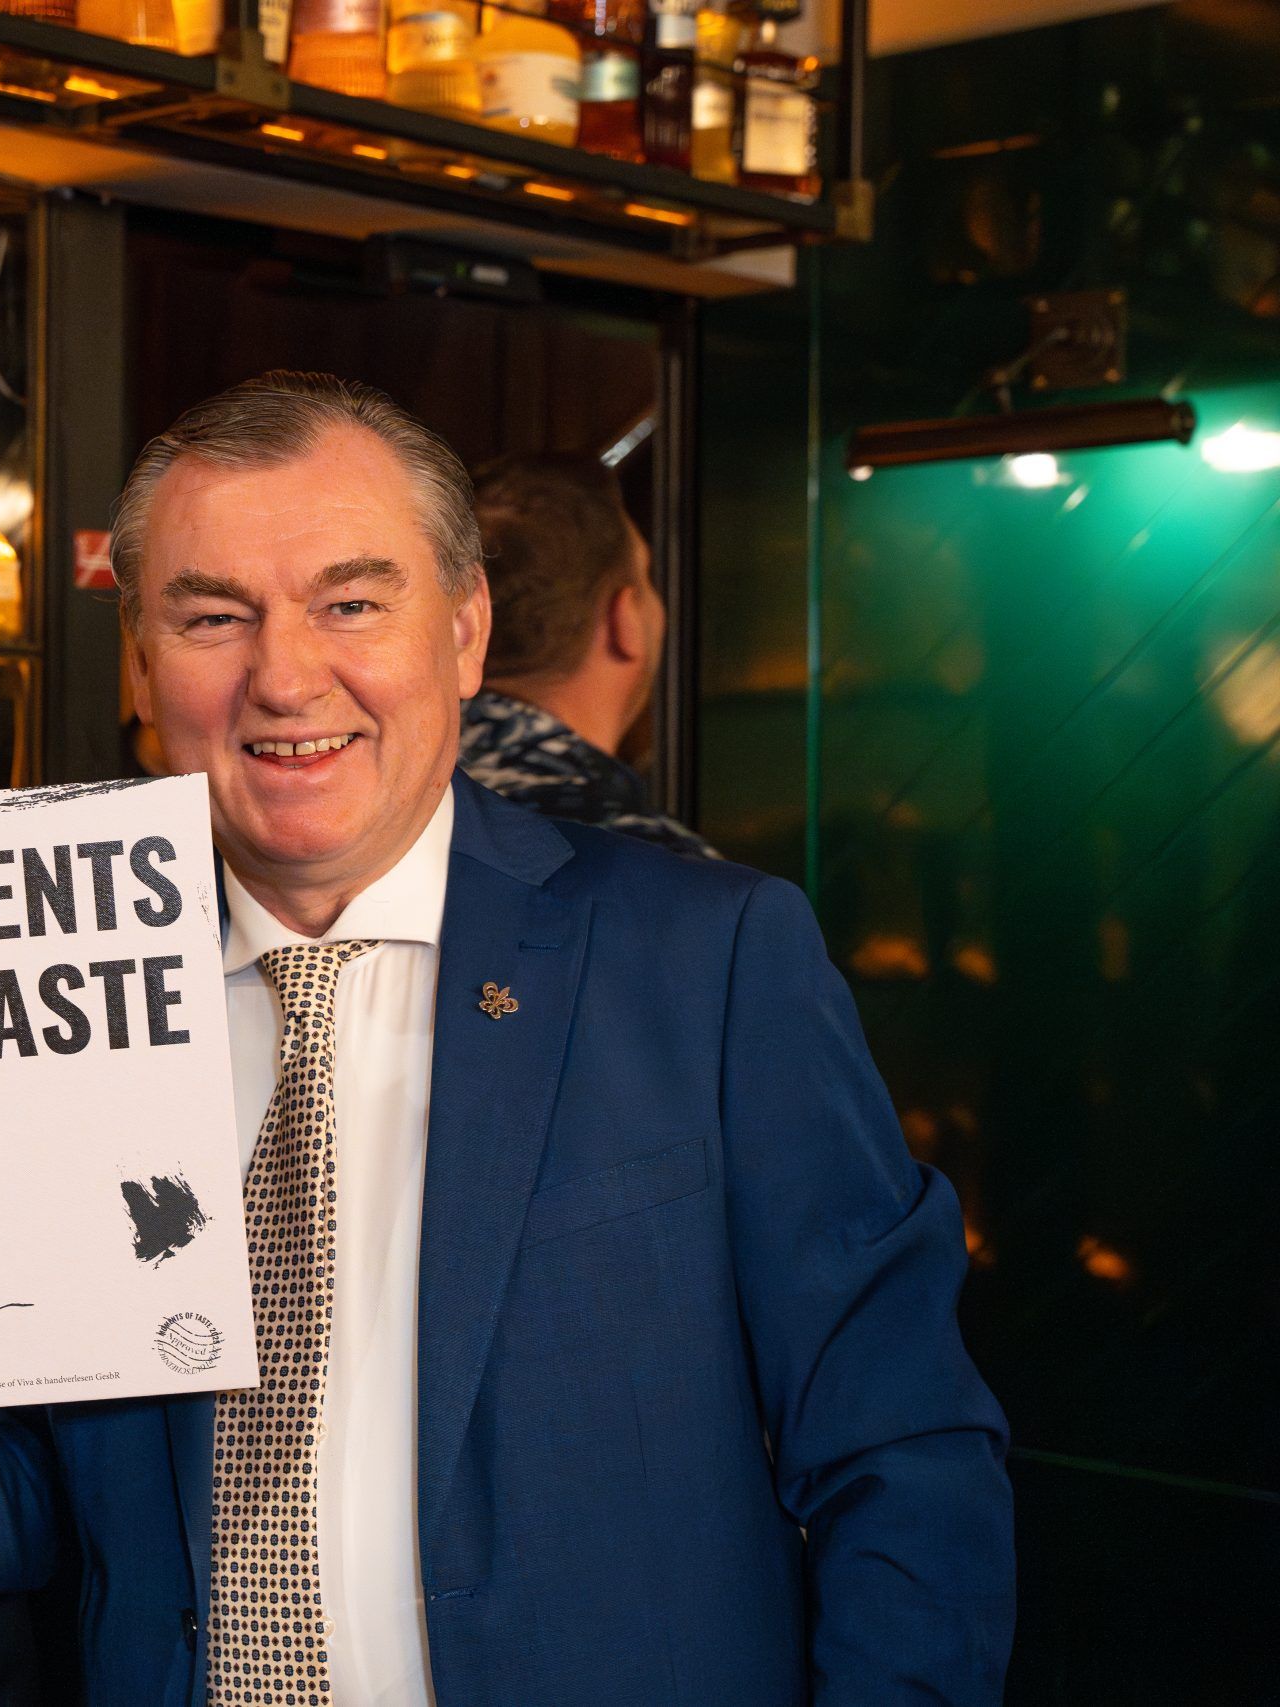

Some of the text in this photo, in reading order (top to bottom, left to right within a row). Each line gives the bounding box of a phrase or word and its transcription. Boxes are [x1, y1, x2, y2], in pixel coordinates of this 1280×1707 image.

[158, 1312, 184, 1337] MOMENTS
[185, 1312, 194, 1320] OF
[195, 1313, 213, 1329] TASTE
[167, 1332, 207, 1356] Approved
[7, 1378, 16, 1387] of
[16, 1378, 34, 1387] Viva
[35, 1377, 43, 1385] &
[43, 1374, 94, 1385] handverlesen
